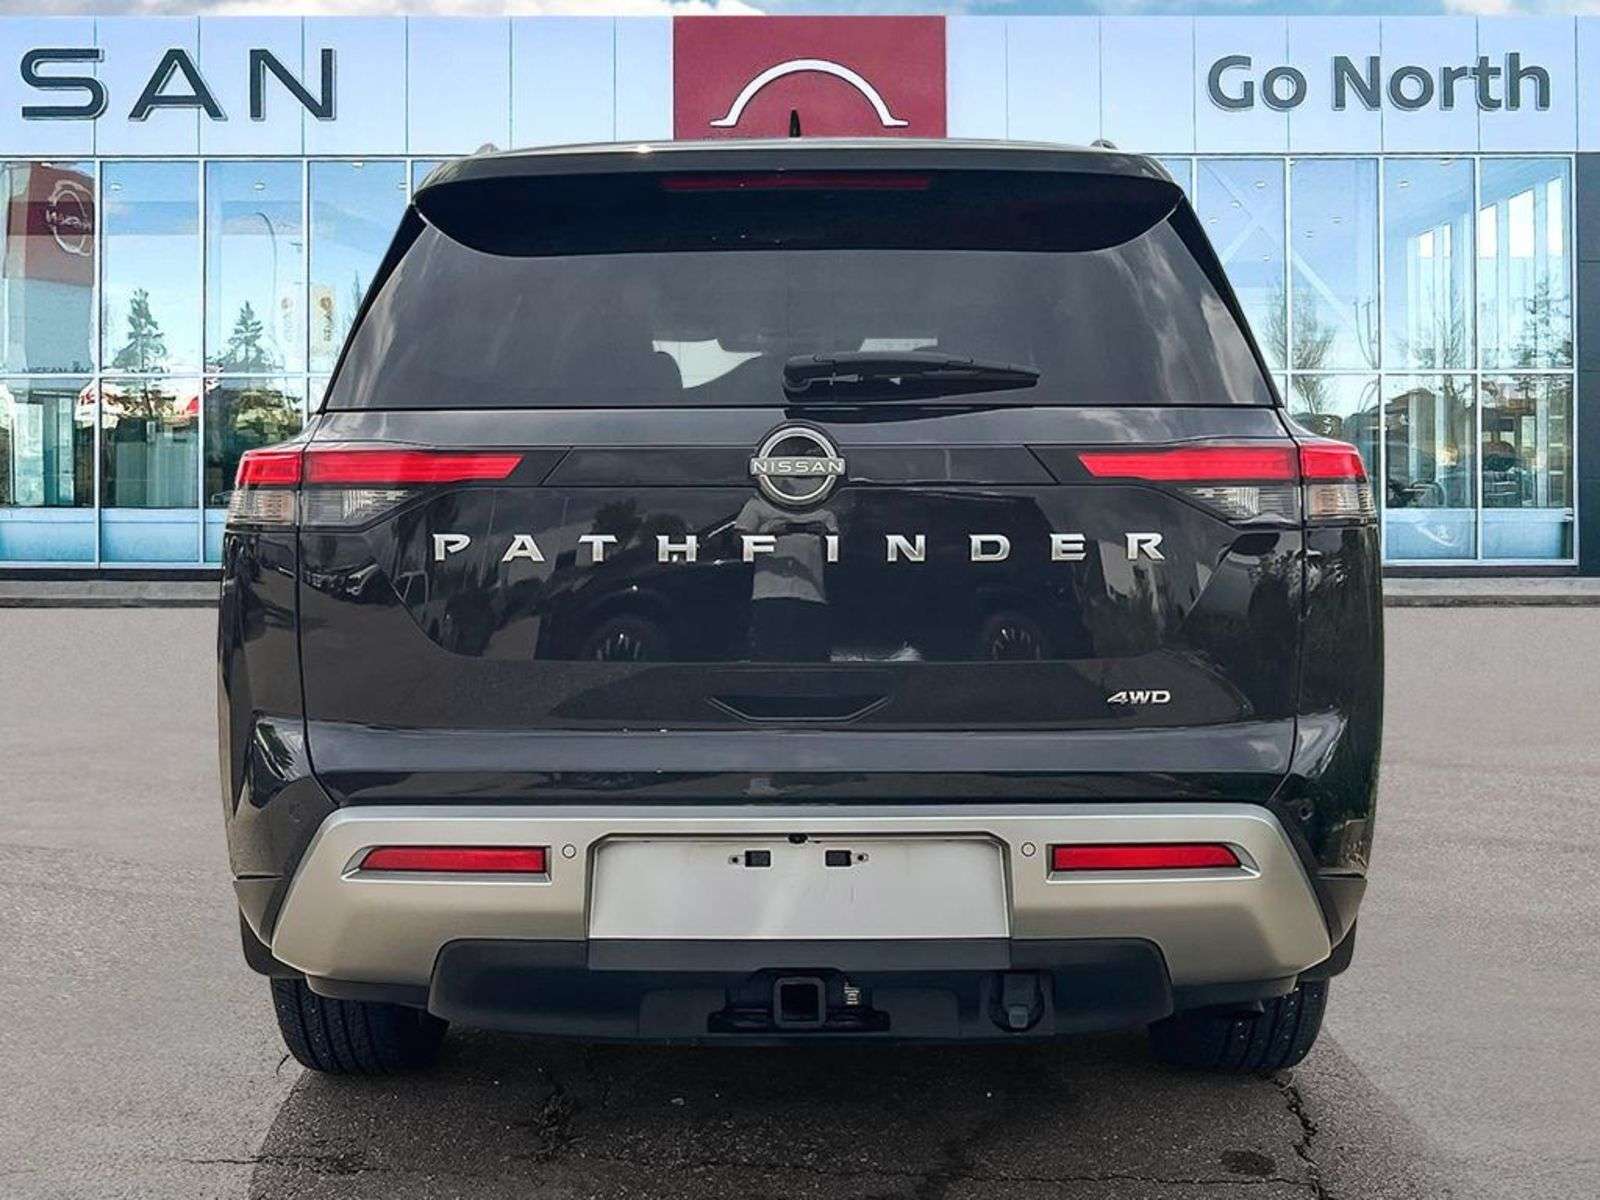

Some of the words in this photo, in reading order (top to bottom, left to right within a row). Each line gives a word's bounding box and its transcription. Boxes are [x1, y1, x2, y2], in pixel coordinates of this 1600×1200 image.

[20, 47, 337, 121] SAN
[1207, 54, 1307, 112] Go
[1331, 52, 1551, 112] North
[753, 460, 842, 473] NISSAN
[432, 532, 1166, 563] PATHFINDER
[1107, 690, 1171, 704] 4WD
